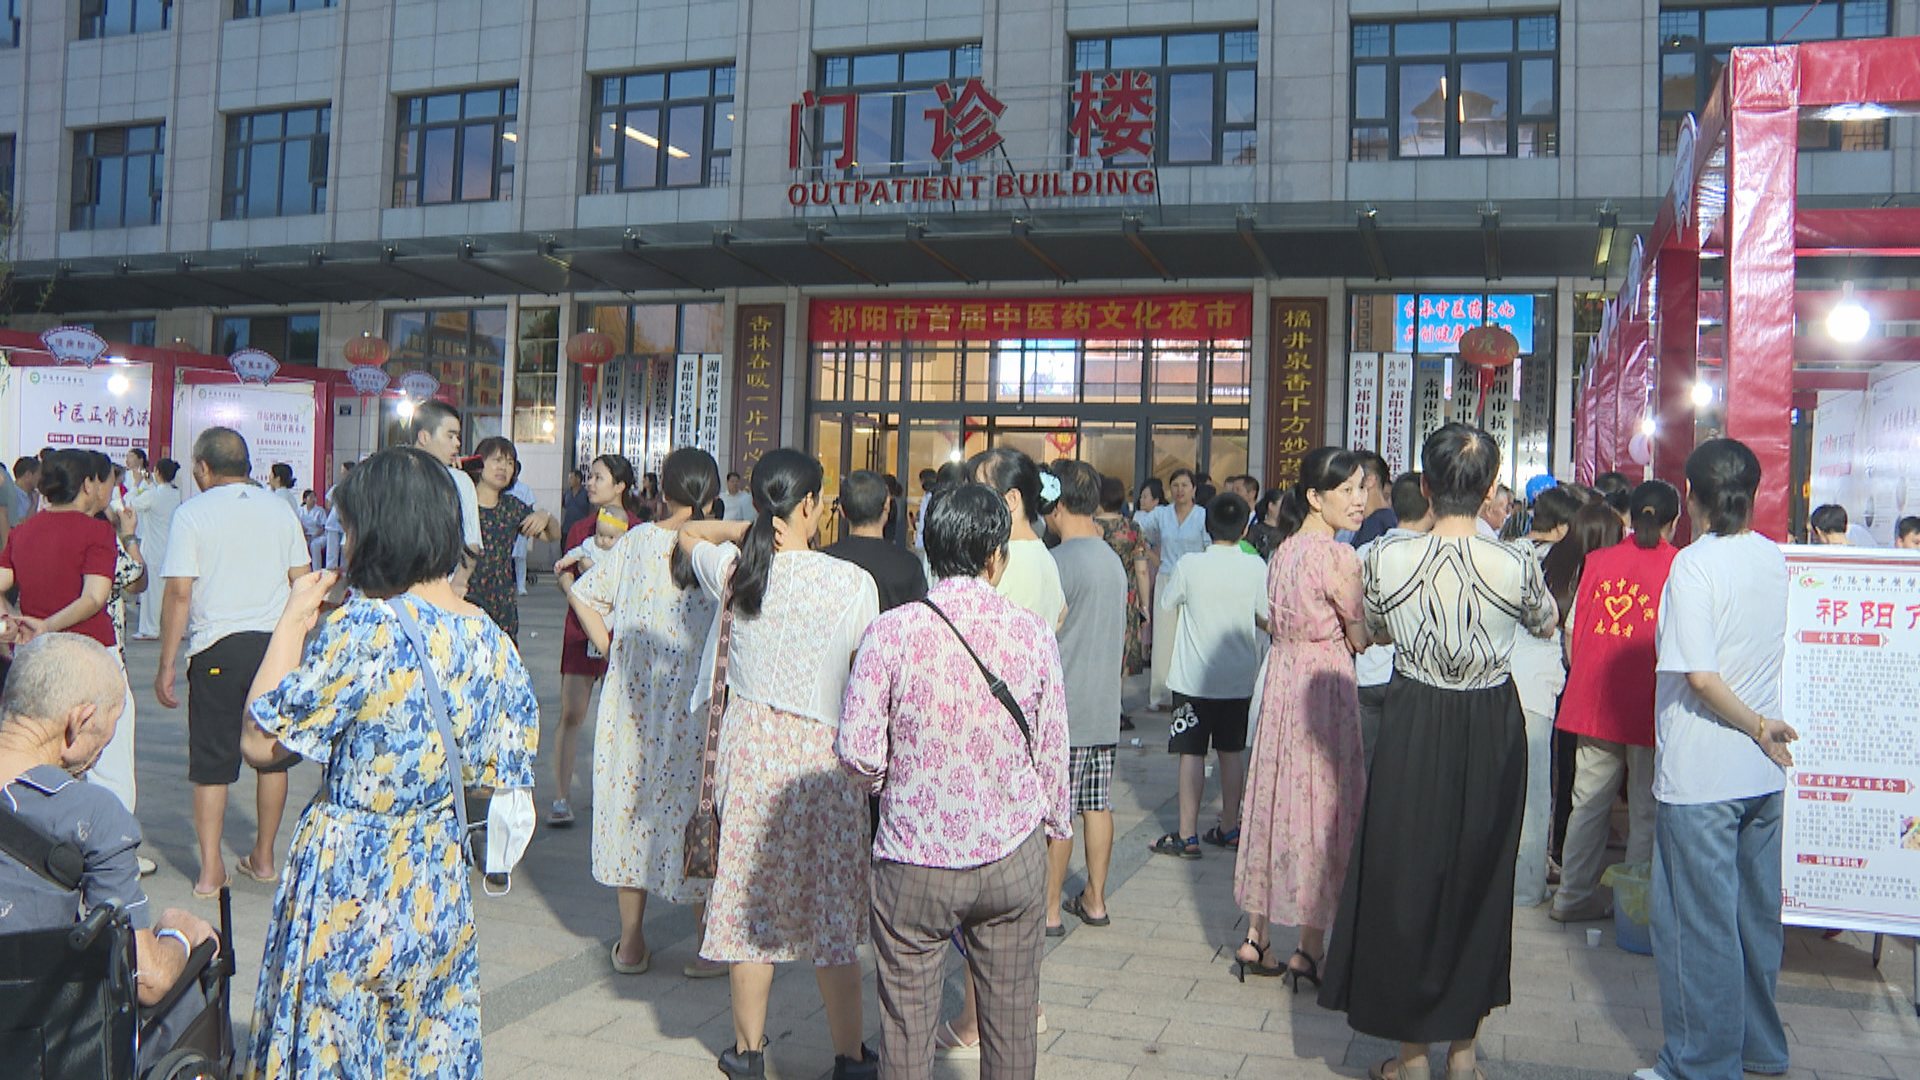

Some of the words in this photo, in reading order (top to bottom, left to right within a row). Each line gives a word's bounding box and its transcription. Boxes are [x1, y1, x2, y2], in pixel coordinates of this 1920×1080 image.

[788, 70, 1156, 170] 门诊楼
[788, 175, 986, 207] OUTPATIENT
[996, 169, 1156, 198] BUILDING
[828, 301, 1237, 334] 祁阳市首届中医药文化夜市
[53, 400, 149, 428] 中医正骨疗法
